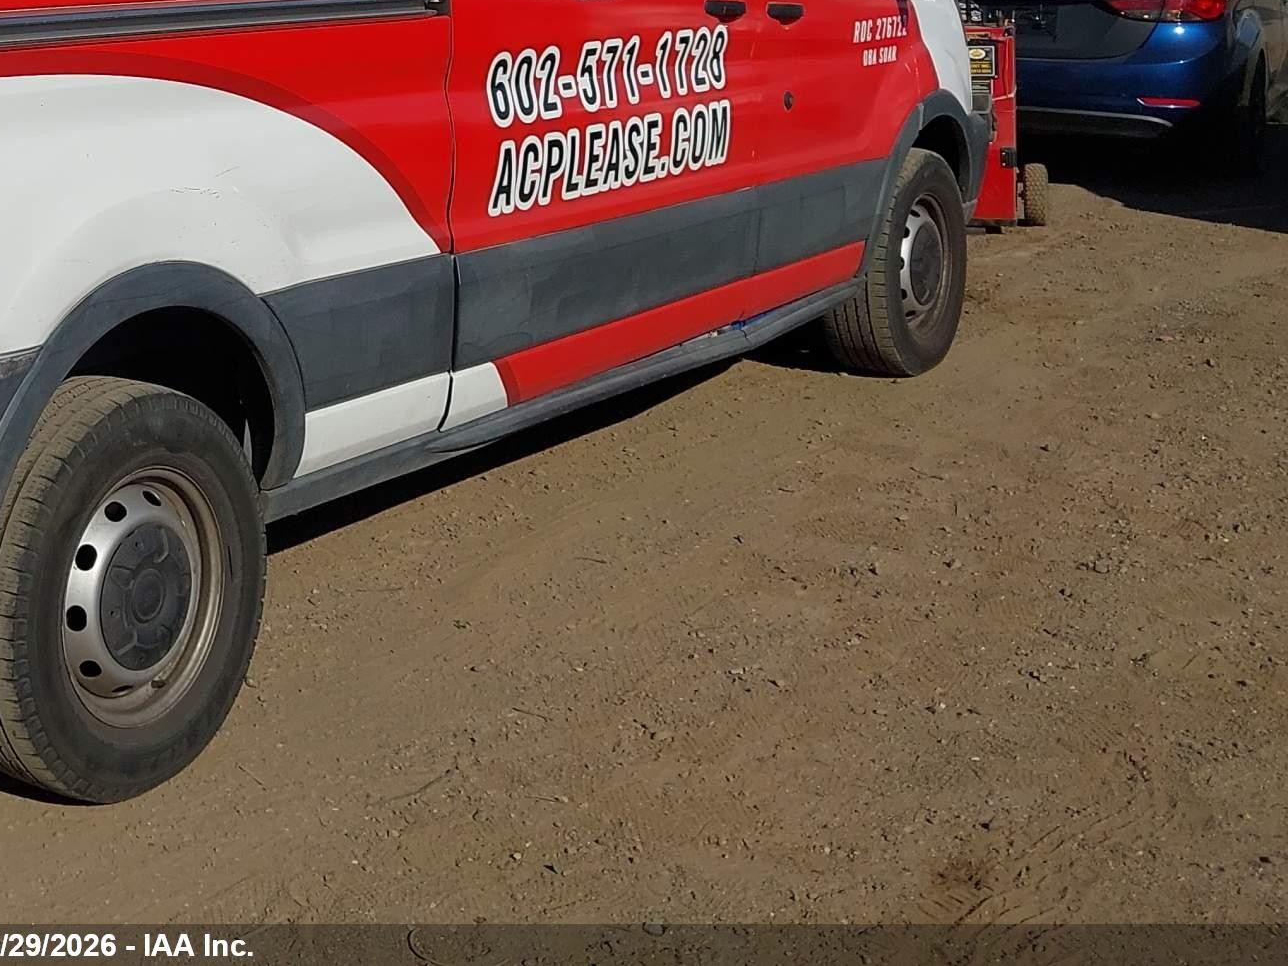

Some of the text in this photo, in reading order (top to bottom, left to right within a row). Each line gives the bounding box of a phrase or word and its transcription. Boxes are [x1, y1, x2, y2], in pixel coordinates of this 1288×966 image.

[487, 26, 729, 127] 602-571-1728
[853, 15, 908, 43] ROC 276722
[489, 100, 730, 215] ACPLEASE.COM
